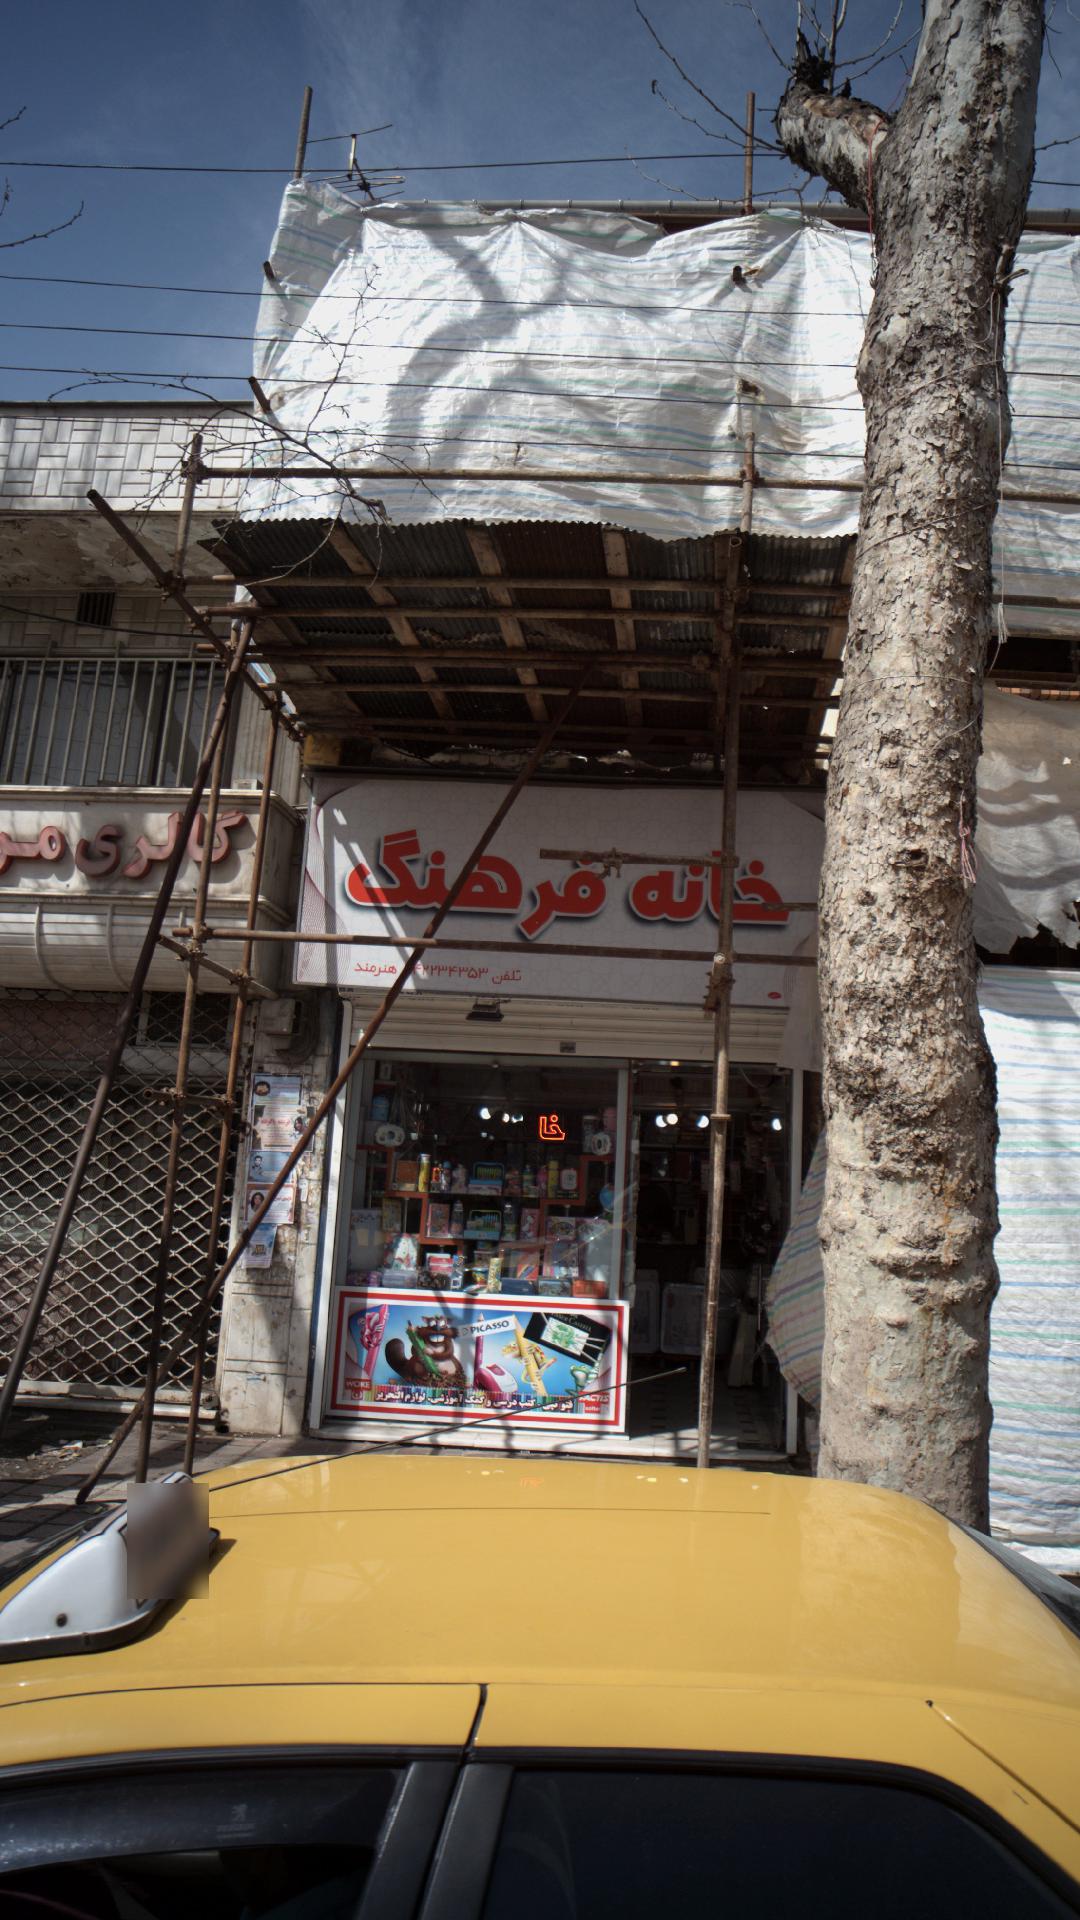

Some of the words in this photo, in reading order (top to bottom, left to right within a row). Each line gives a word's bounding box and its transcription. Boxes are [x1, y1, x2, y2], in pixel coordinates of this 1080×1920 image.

[344, 828, 608, 939] فرهنگ
[631, 849, 791, 924] خانه
[353, 962, 398, 977] هنرمند
[491, 969, 522, 985] تلفن
[470, 1320, 510, 1334] PICASSO
[464, 1395, 485, 1404] کمک
[493, 1399, 518, 1408] درسی
